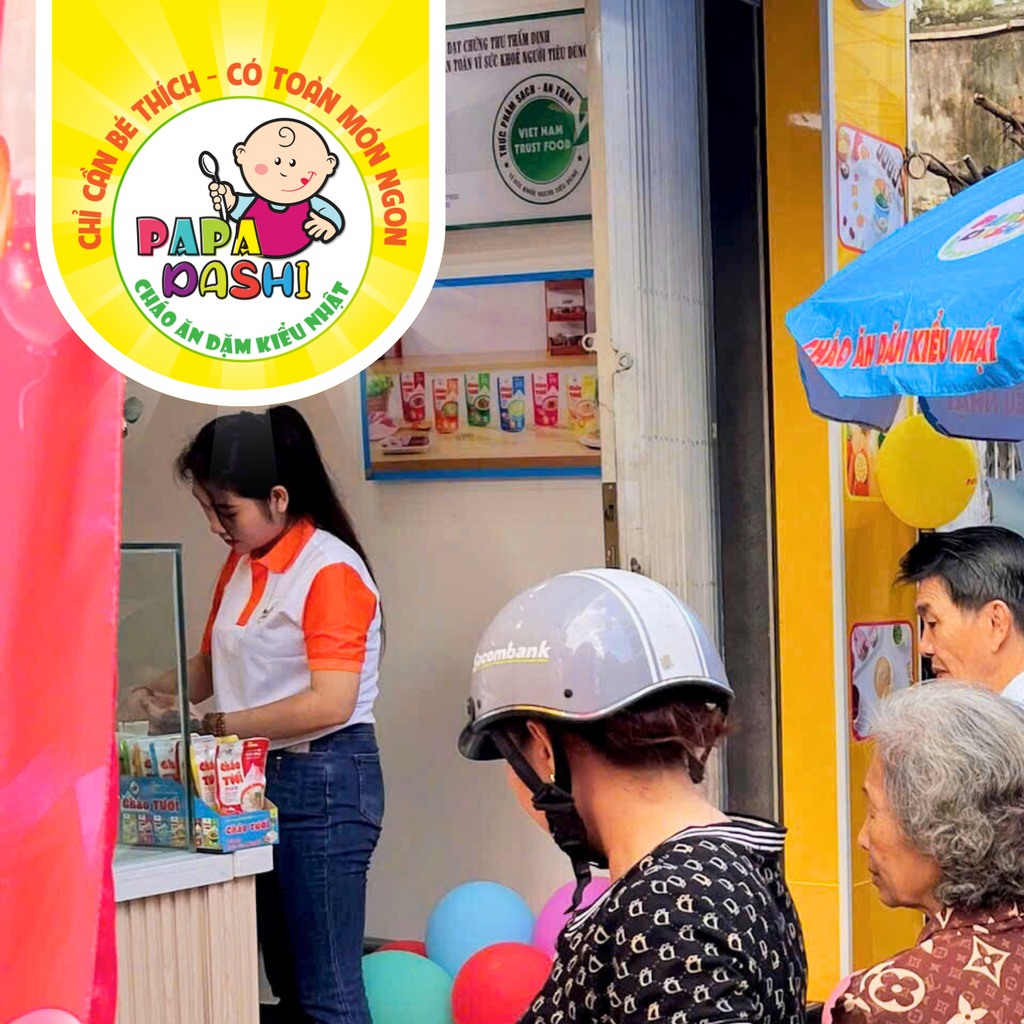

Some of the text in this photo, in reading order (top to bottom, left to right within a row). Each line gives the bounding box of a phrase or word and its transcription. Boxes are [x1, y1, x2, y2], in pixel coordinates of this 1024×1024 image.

[518, 125, 563, 139] VIET NAM
[514, 140, 571, 155] TRUST FOOD
[908, 308, 951, 364] KIỂU
